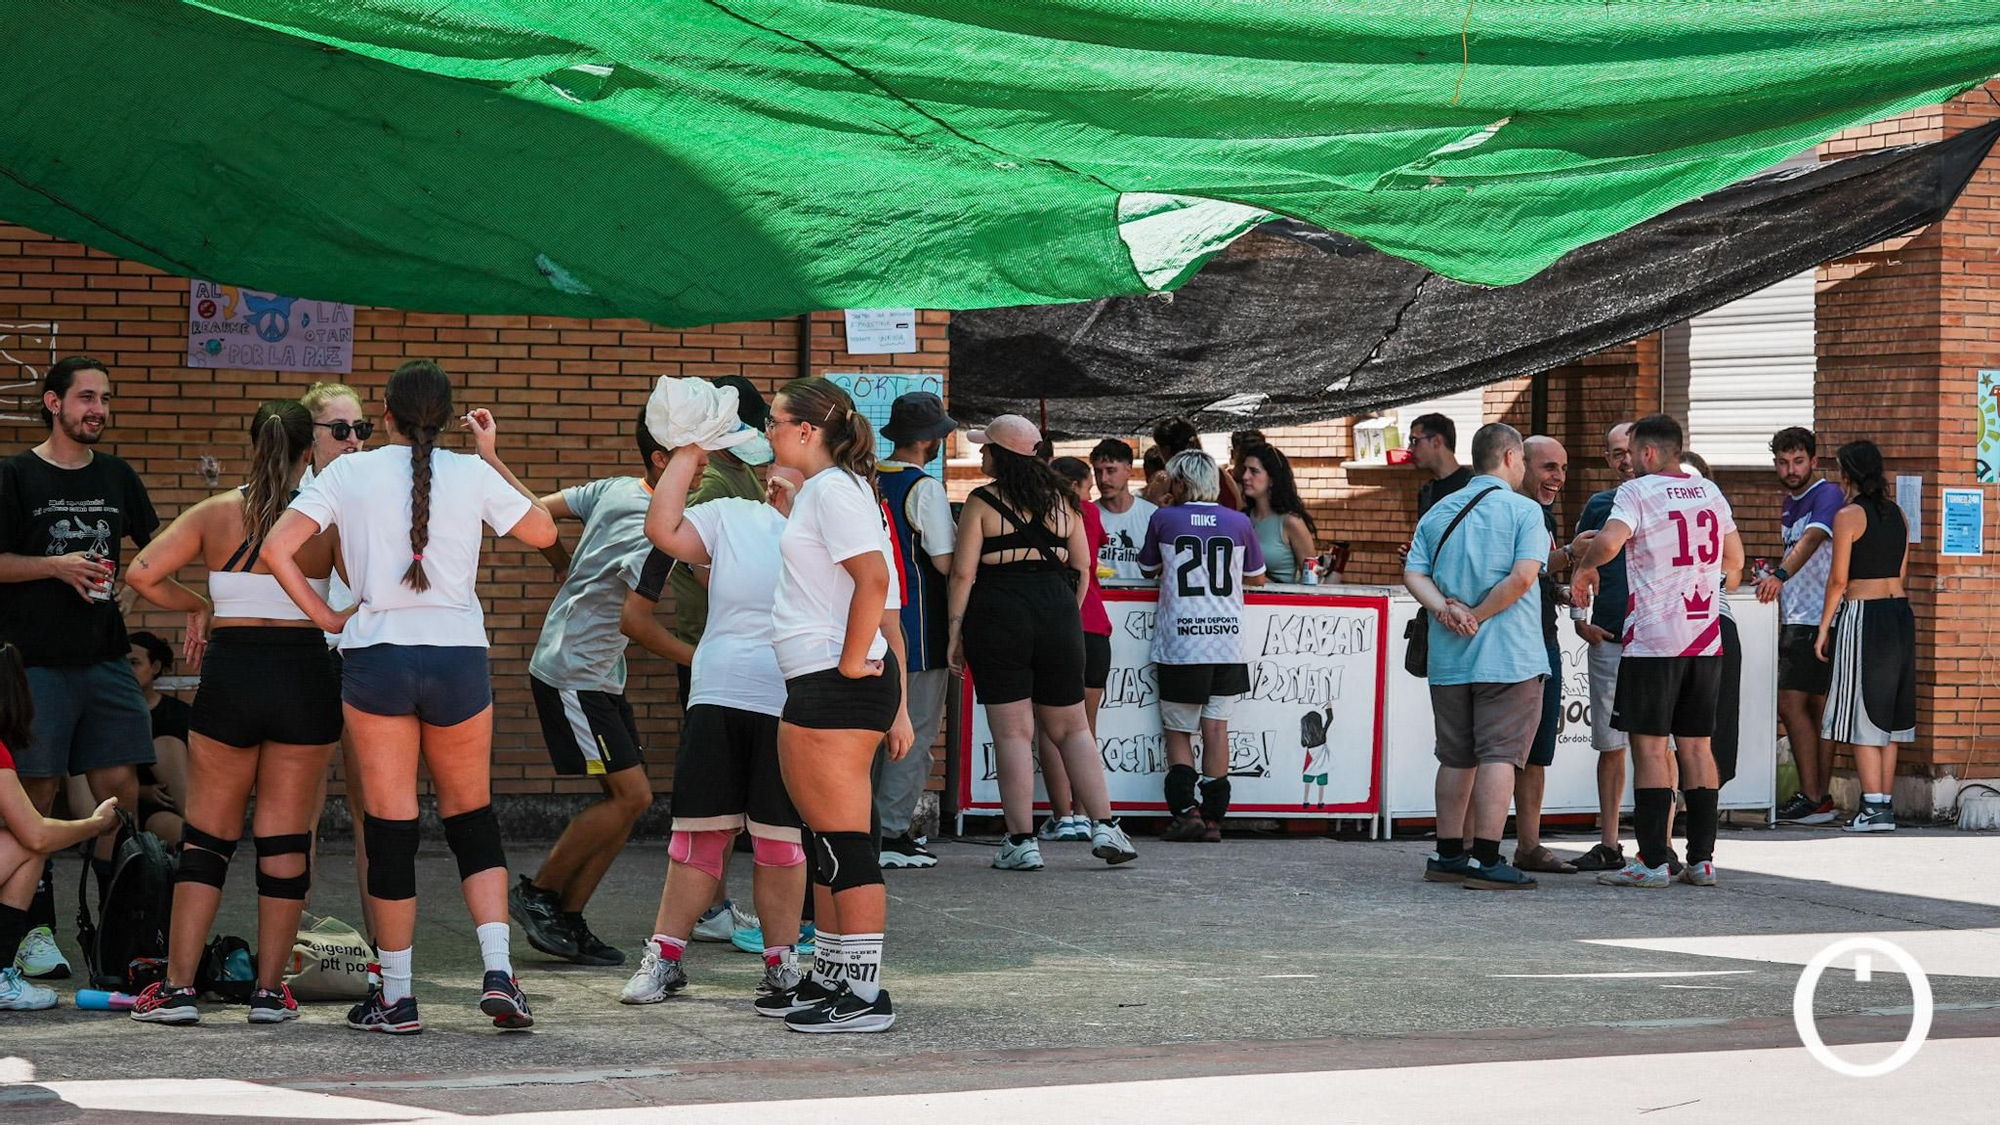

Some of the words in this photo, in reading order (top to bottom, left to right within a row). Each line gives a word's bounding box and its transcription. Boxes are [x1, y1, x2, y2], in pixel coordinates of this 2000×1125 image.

[196, 283, 221, 298] AL
[317, 302, 348, 323] LA
[192, 321, 250, 335] REARME
[305, 328, 351, 342] OTAN
[229, 344, 263, 365] POR
[269, 345, 296, 366] LA
[303, 346, 342, 367] PAZ
[1666, 487, 1707, 500] FERNET
[1190, 514, 1217, 526] MIKE
[1668, 509, 1719, 567] 13
[1174, 535, 1234, 597] 20
[1177, 625, 1239, 636] INCLUSIVO
[1261, 614, 1374, 656] ACABAN
[320, 957, 341, 972] ptt
[813, 956, 843, 980] 1977
[844, 962, 877, 982] 1977
